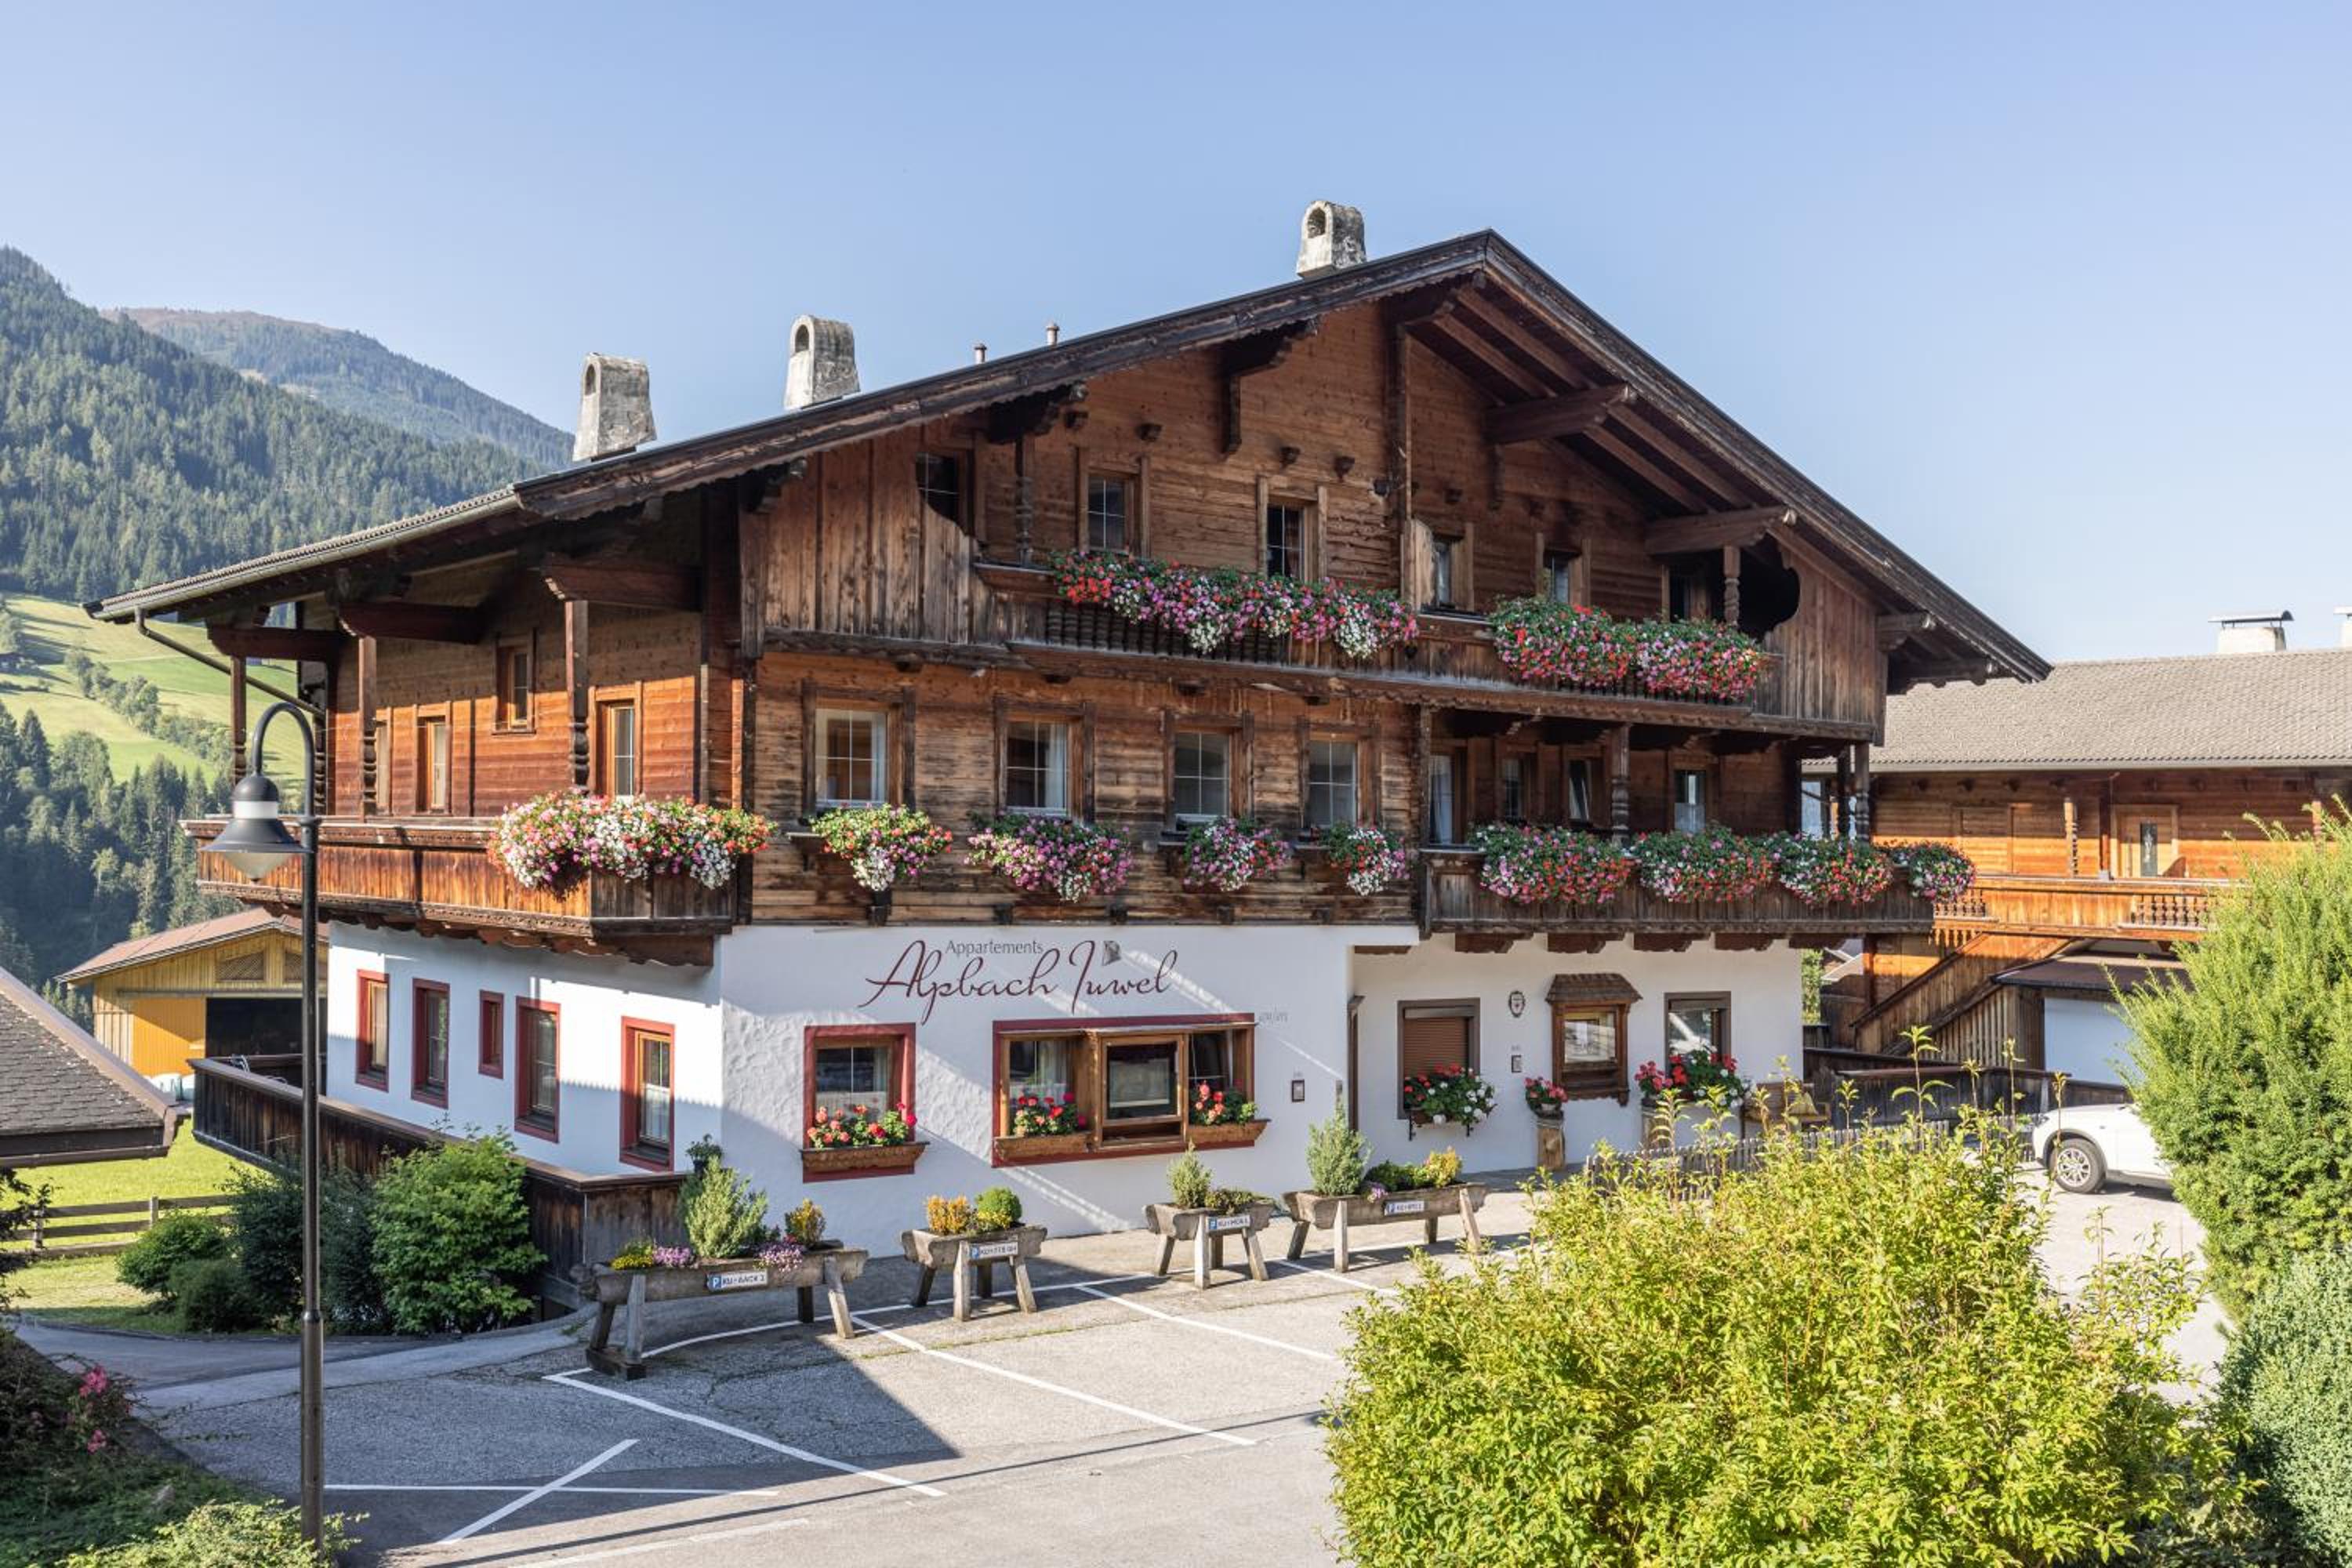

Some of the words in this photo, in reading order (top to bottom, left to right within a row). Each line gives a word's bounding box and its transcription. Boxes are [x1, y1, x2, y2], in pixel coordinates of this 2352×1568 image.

[945, 939, 1044, 958] Appartements
[857, 940, 1061, 1026] Alpbach
[1068, 940, 1178, 1016] Juwel
